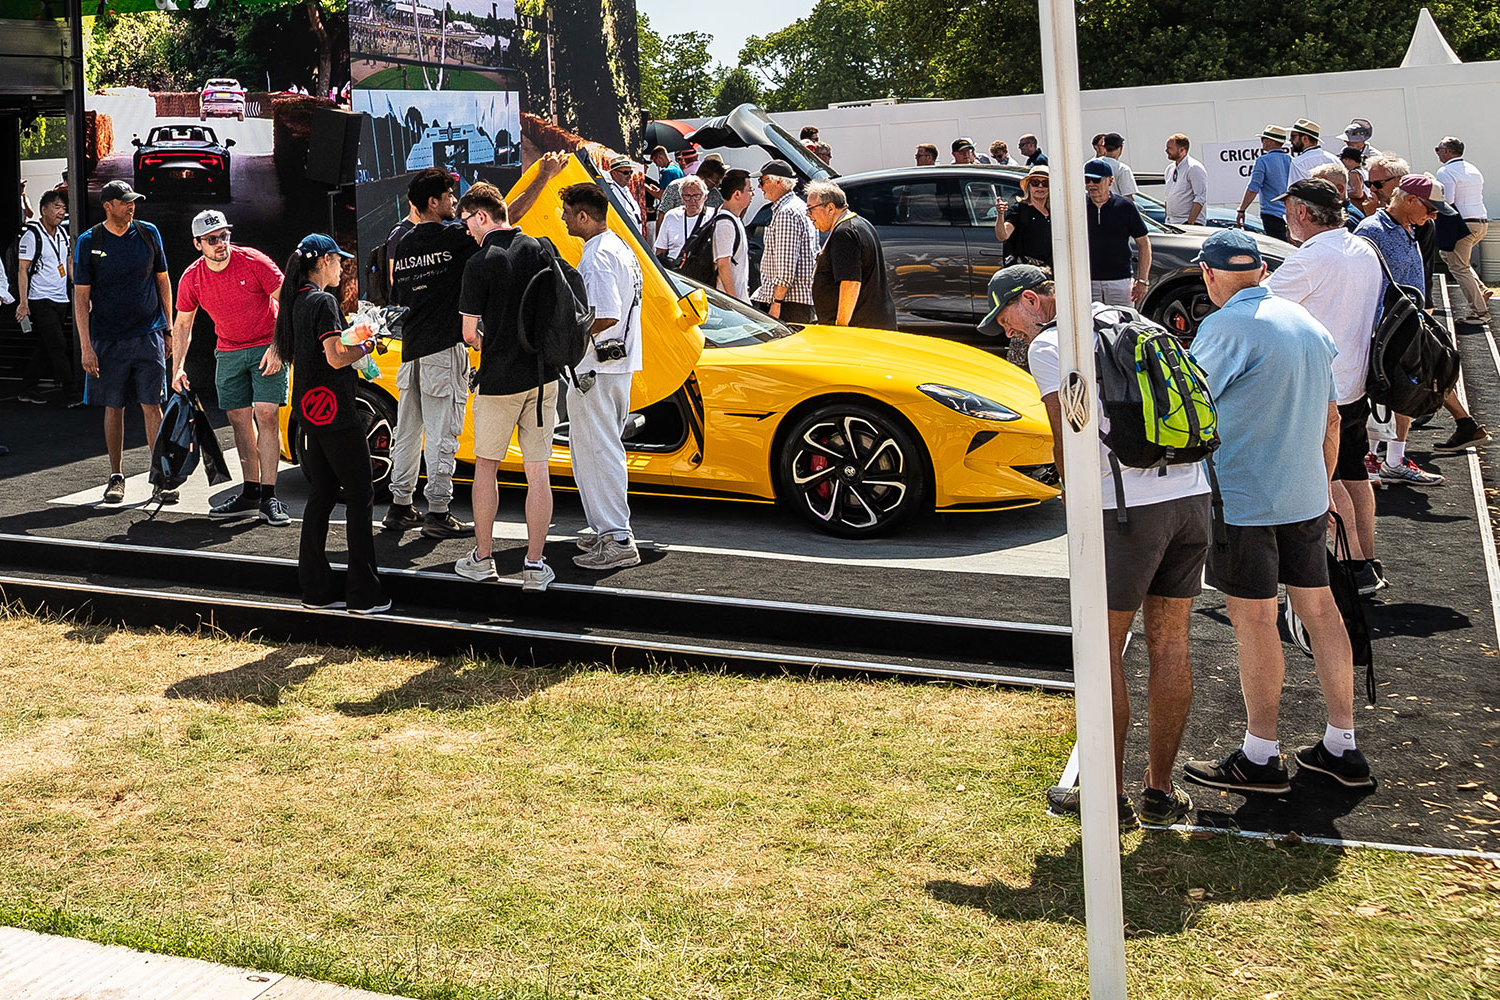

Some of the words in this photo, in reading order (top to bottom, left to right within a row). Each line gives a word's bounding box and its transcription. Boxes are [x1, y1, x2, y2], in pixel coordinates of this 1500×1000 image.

[204, 216, 220, 226] EBC
[394, 250, 453, 273] ALLSAINTS
[305, 391, 334, 421] MG
